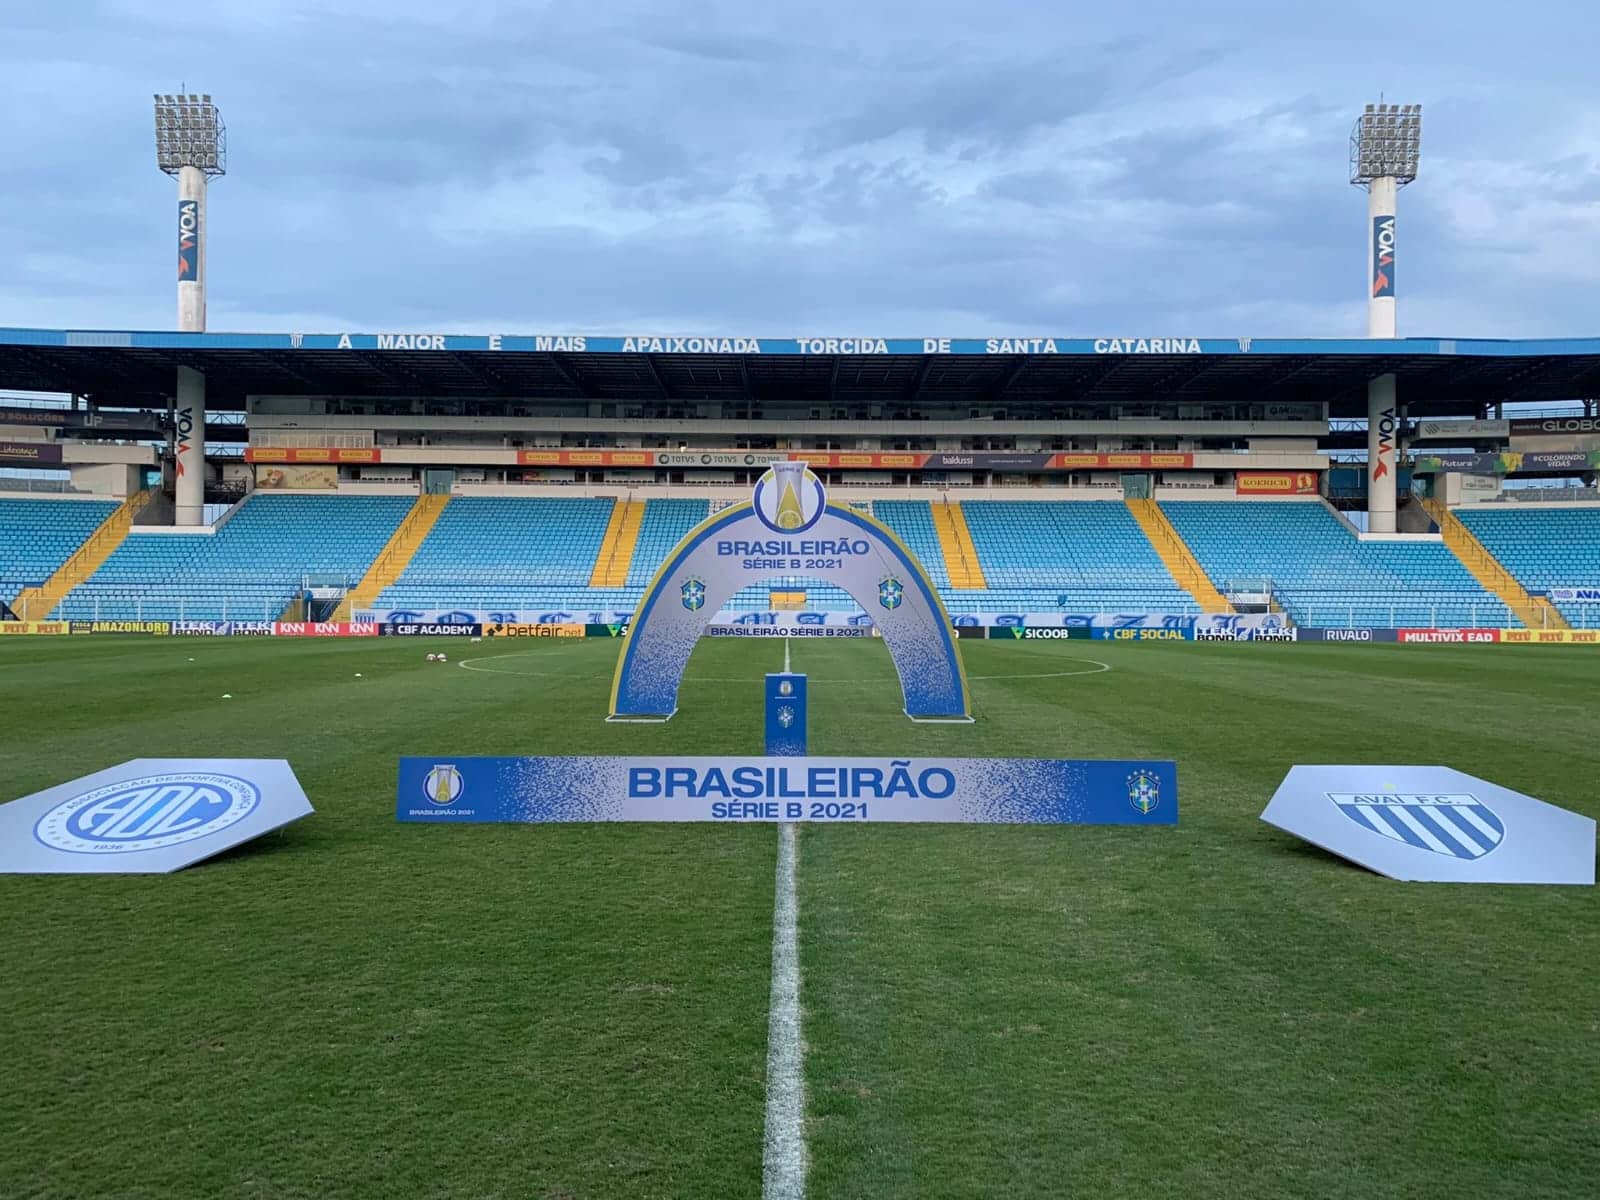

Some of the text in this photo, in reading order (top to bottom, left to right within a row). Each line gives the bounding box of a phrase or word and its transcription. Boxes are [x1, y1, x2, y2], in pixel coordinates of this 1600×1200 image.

[338, 334, 1202, 354] A MAIOR E MAIS APAIXONADA TORCIDA DE SANTA CATARINA
[942, 455, 973, 465] baldussi
[717, 537, 870, 556] BRASILEIRÃO
[743, 558, 843, 570] SÉRIE B 2021
[280, 624, 304, 633] KNN
[315, 624, 339, 633] KNN
[350, 624, 374, 633] KNN
[398, 625, 474, 635] CBF ACADEMY
[711, 626, 865, 637] BRASILEIRÃO SÉRIE B 2021
[1025, 629, 1069, 639] SICOOB
[1113, 630, 1185, 640] CBF SOCIAL
[1327, 630, 1369, 640] RIVALO
[1405, 632, 1493, 643] MULTIVIX EAD
[628, 761, 956, 799] BRASILEIRÃO
[1415, 796, 1461, 804] F.C.
[711, 799, 867, 819] SÉRIE B 2021
